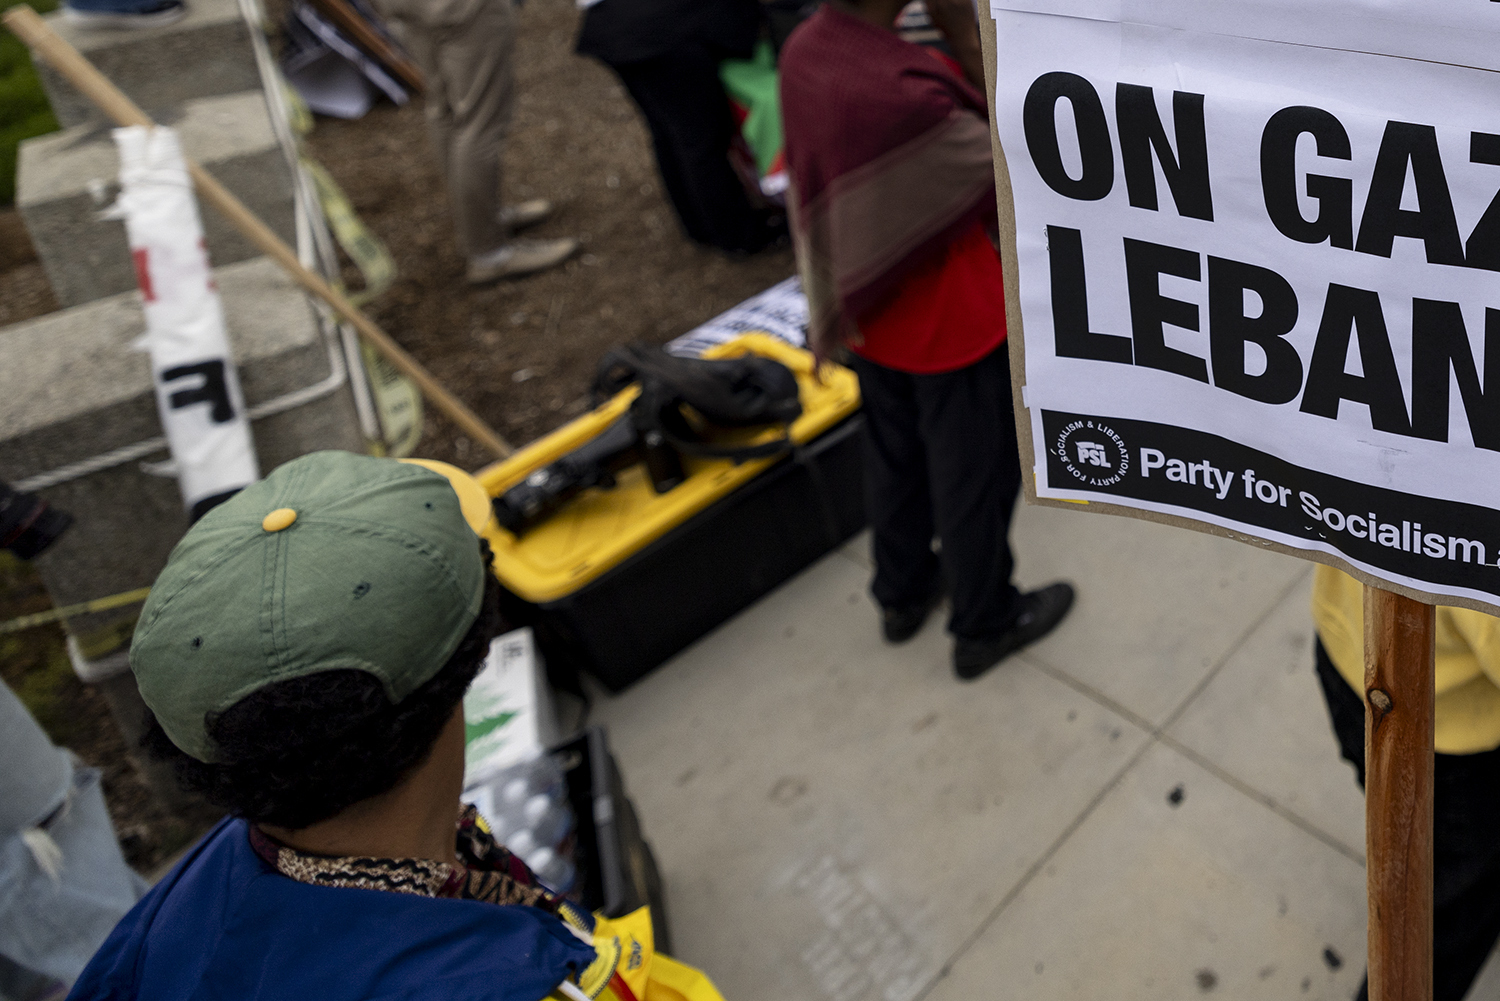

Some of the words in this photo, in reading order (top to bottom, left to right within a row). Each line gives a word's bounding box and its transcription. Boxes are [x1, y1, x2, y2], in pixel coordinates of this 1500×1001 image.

[1023, 72, 1214, 222] ON
[1077, 448, 1112, 468] PSL
[1097, 423, 1129, 476] LIBERATION
[1066, 464, 1087, 481] FOR
[1090, 474, 1121, 486] PARTY
[1141, 448, 1234, 500] Party
[1242, 470, 1292, 507] for
[1299, 492, 1485, 565] Socialism
